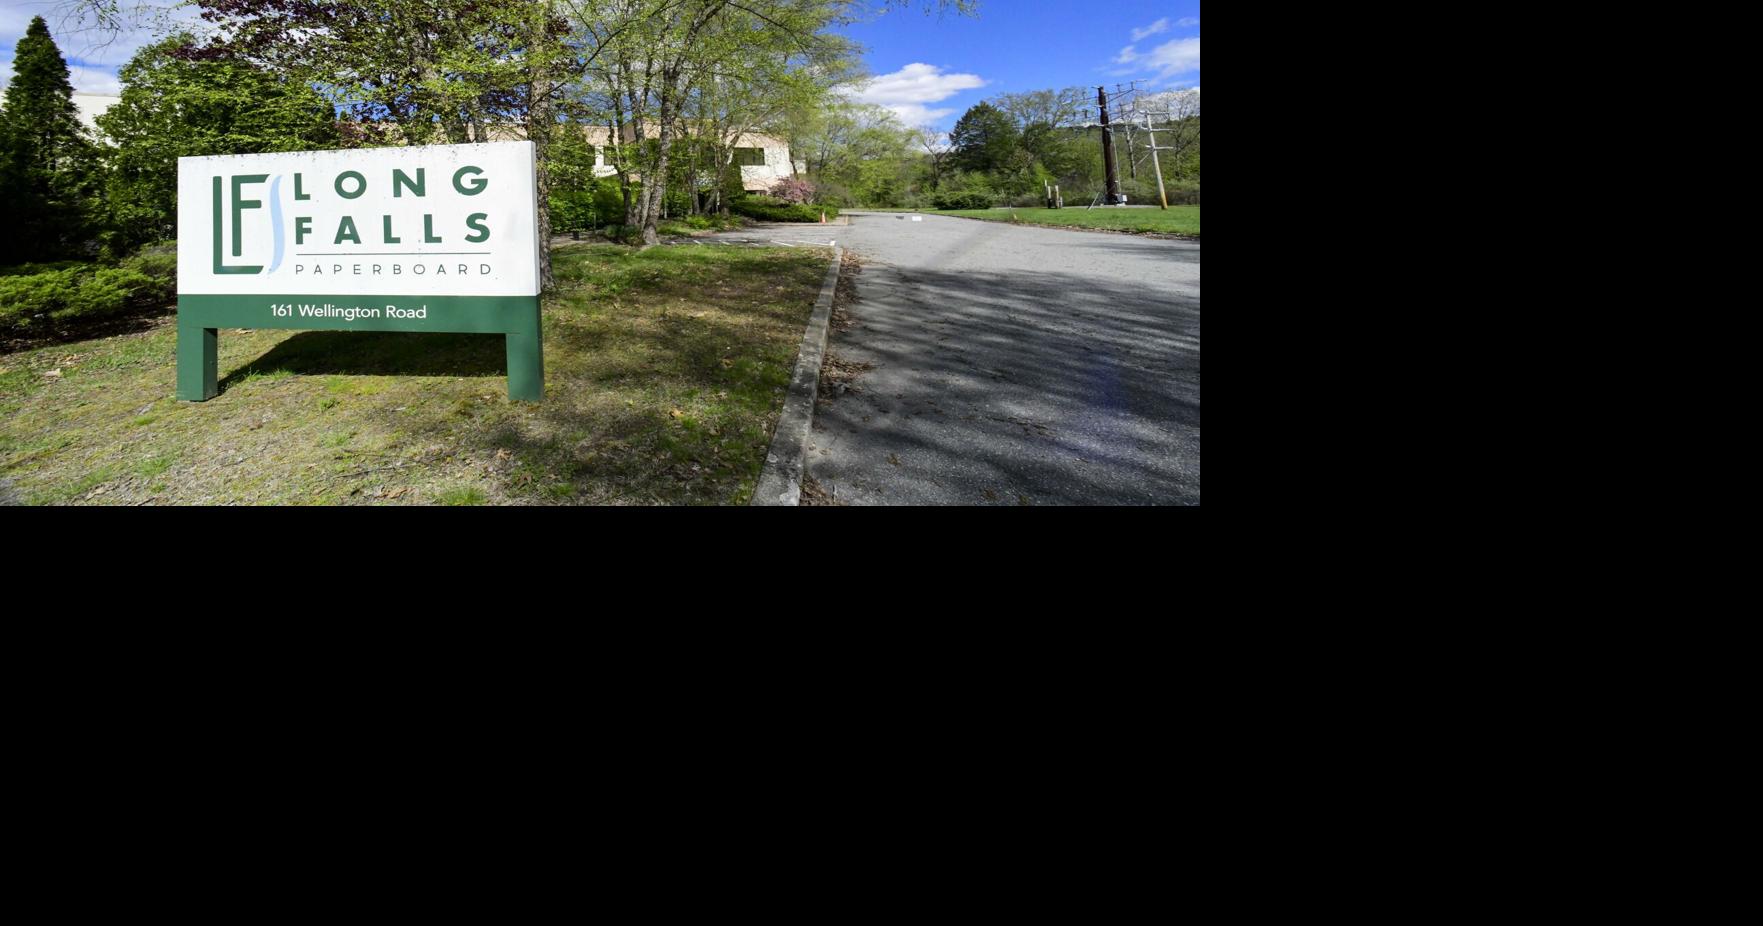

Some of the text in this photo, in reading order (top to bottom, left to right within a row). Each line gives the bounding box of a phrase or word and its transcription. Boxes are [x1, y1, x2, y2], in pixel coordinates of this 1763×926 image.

[294, 165, 489, 201] LONG
[295, 212, 491, 245] FALLS
[295, 263, 491, 276] PAPERBOARD
[270, 303, 427, 321] 161 Wellington Road
